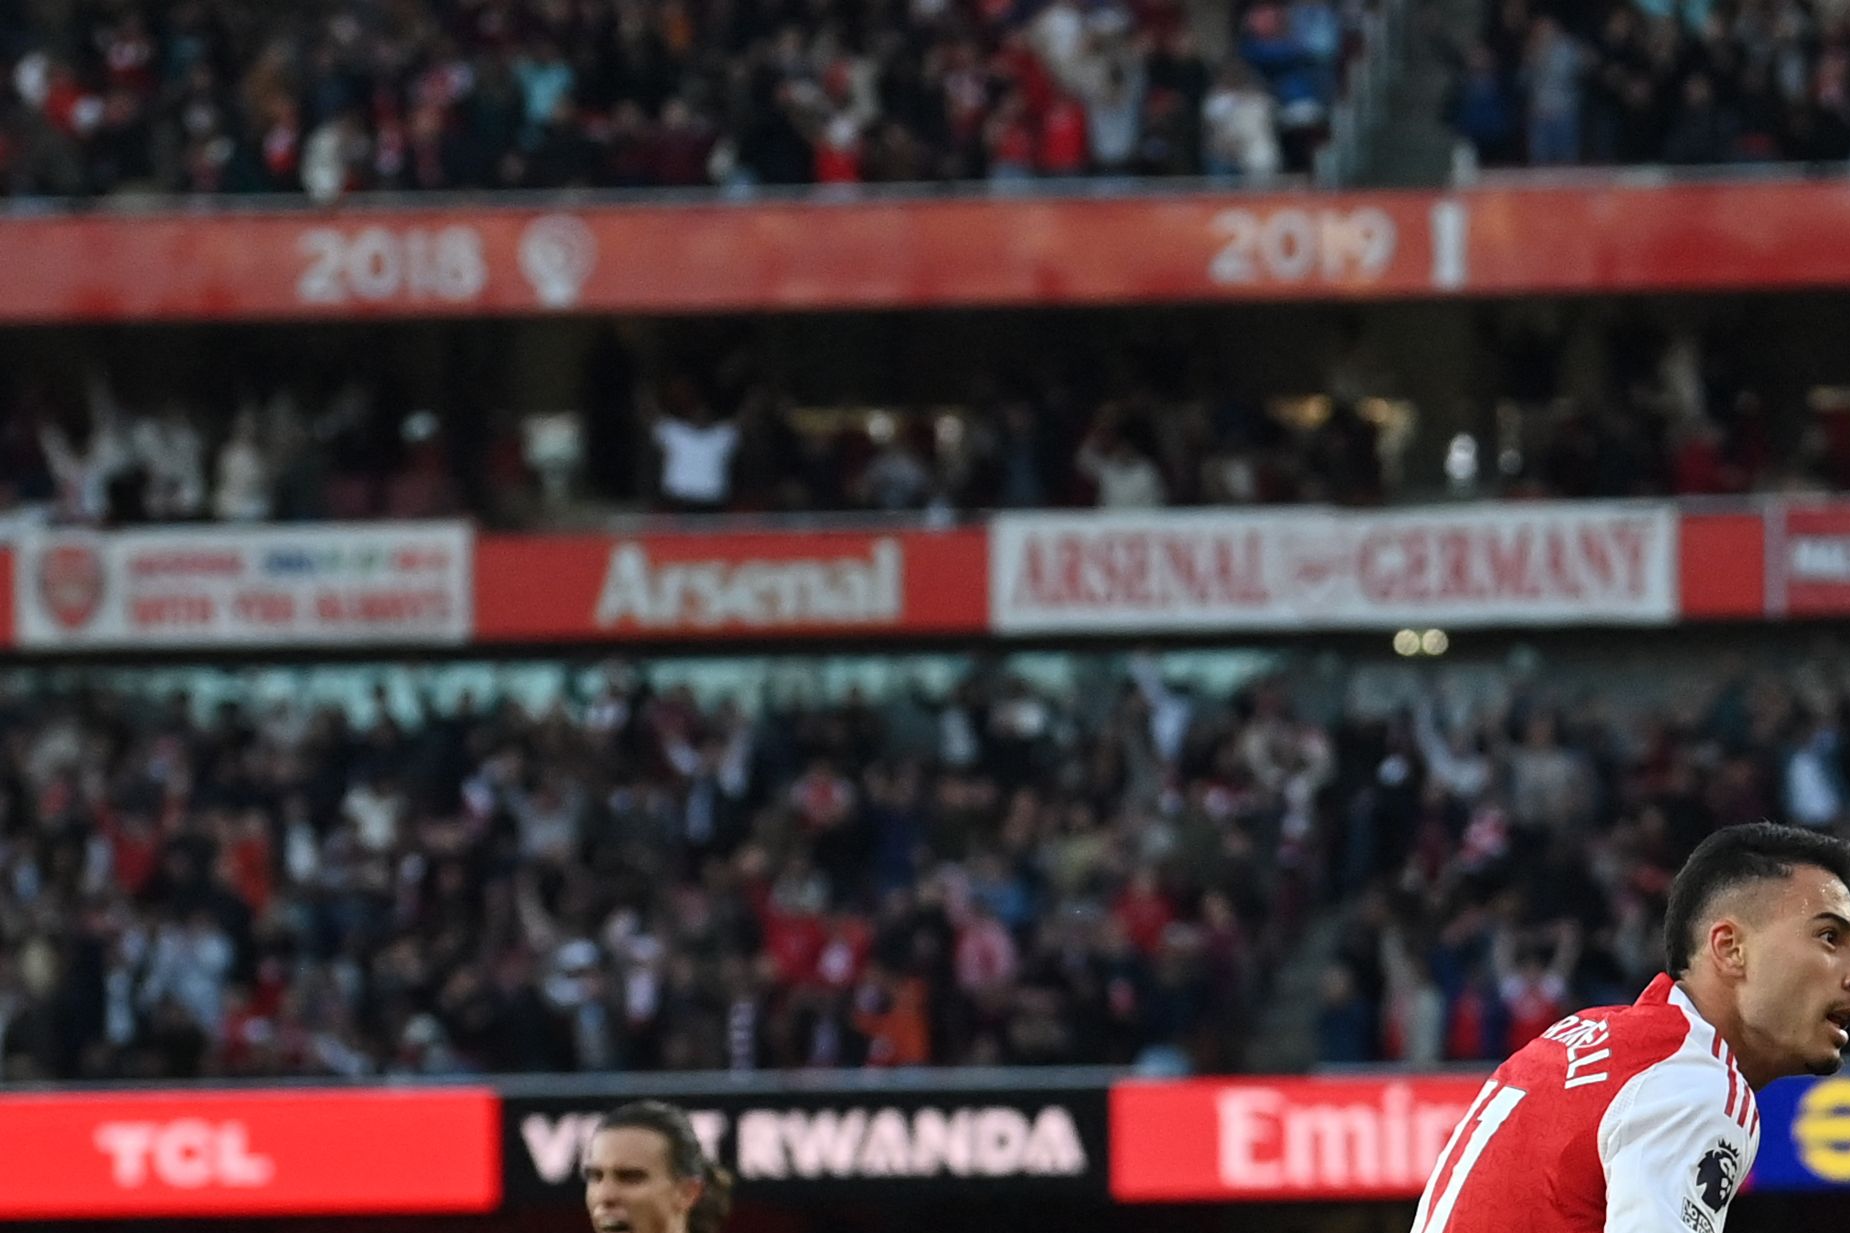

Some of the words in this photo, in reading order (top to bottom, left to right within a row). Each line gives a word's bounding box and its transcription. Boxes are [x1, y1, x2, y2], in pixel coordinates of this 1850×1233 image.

[298, 227, 487, 305] 2018
[1209, 207, 1397, 285] 2019
[596, 537, 904, 630] Arsenal
[1014, 527, 1272, 608] ARSENAL
[95, 1118, 274, 1188] TCL
[736, 1104, 1088, 1180] RWANDA
[1216, 1084, 1466, 1190] Emir
